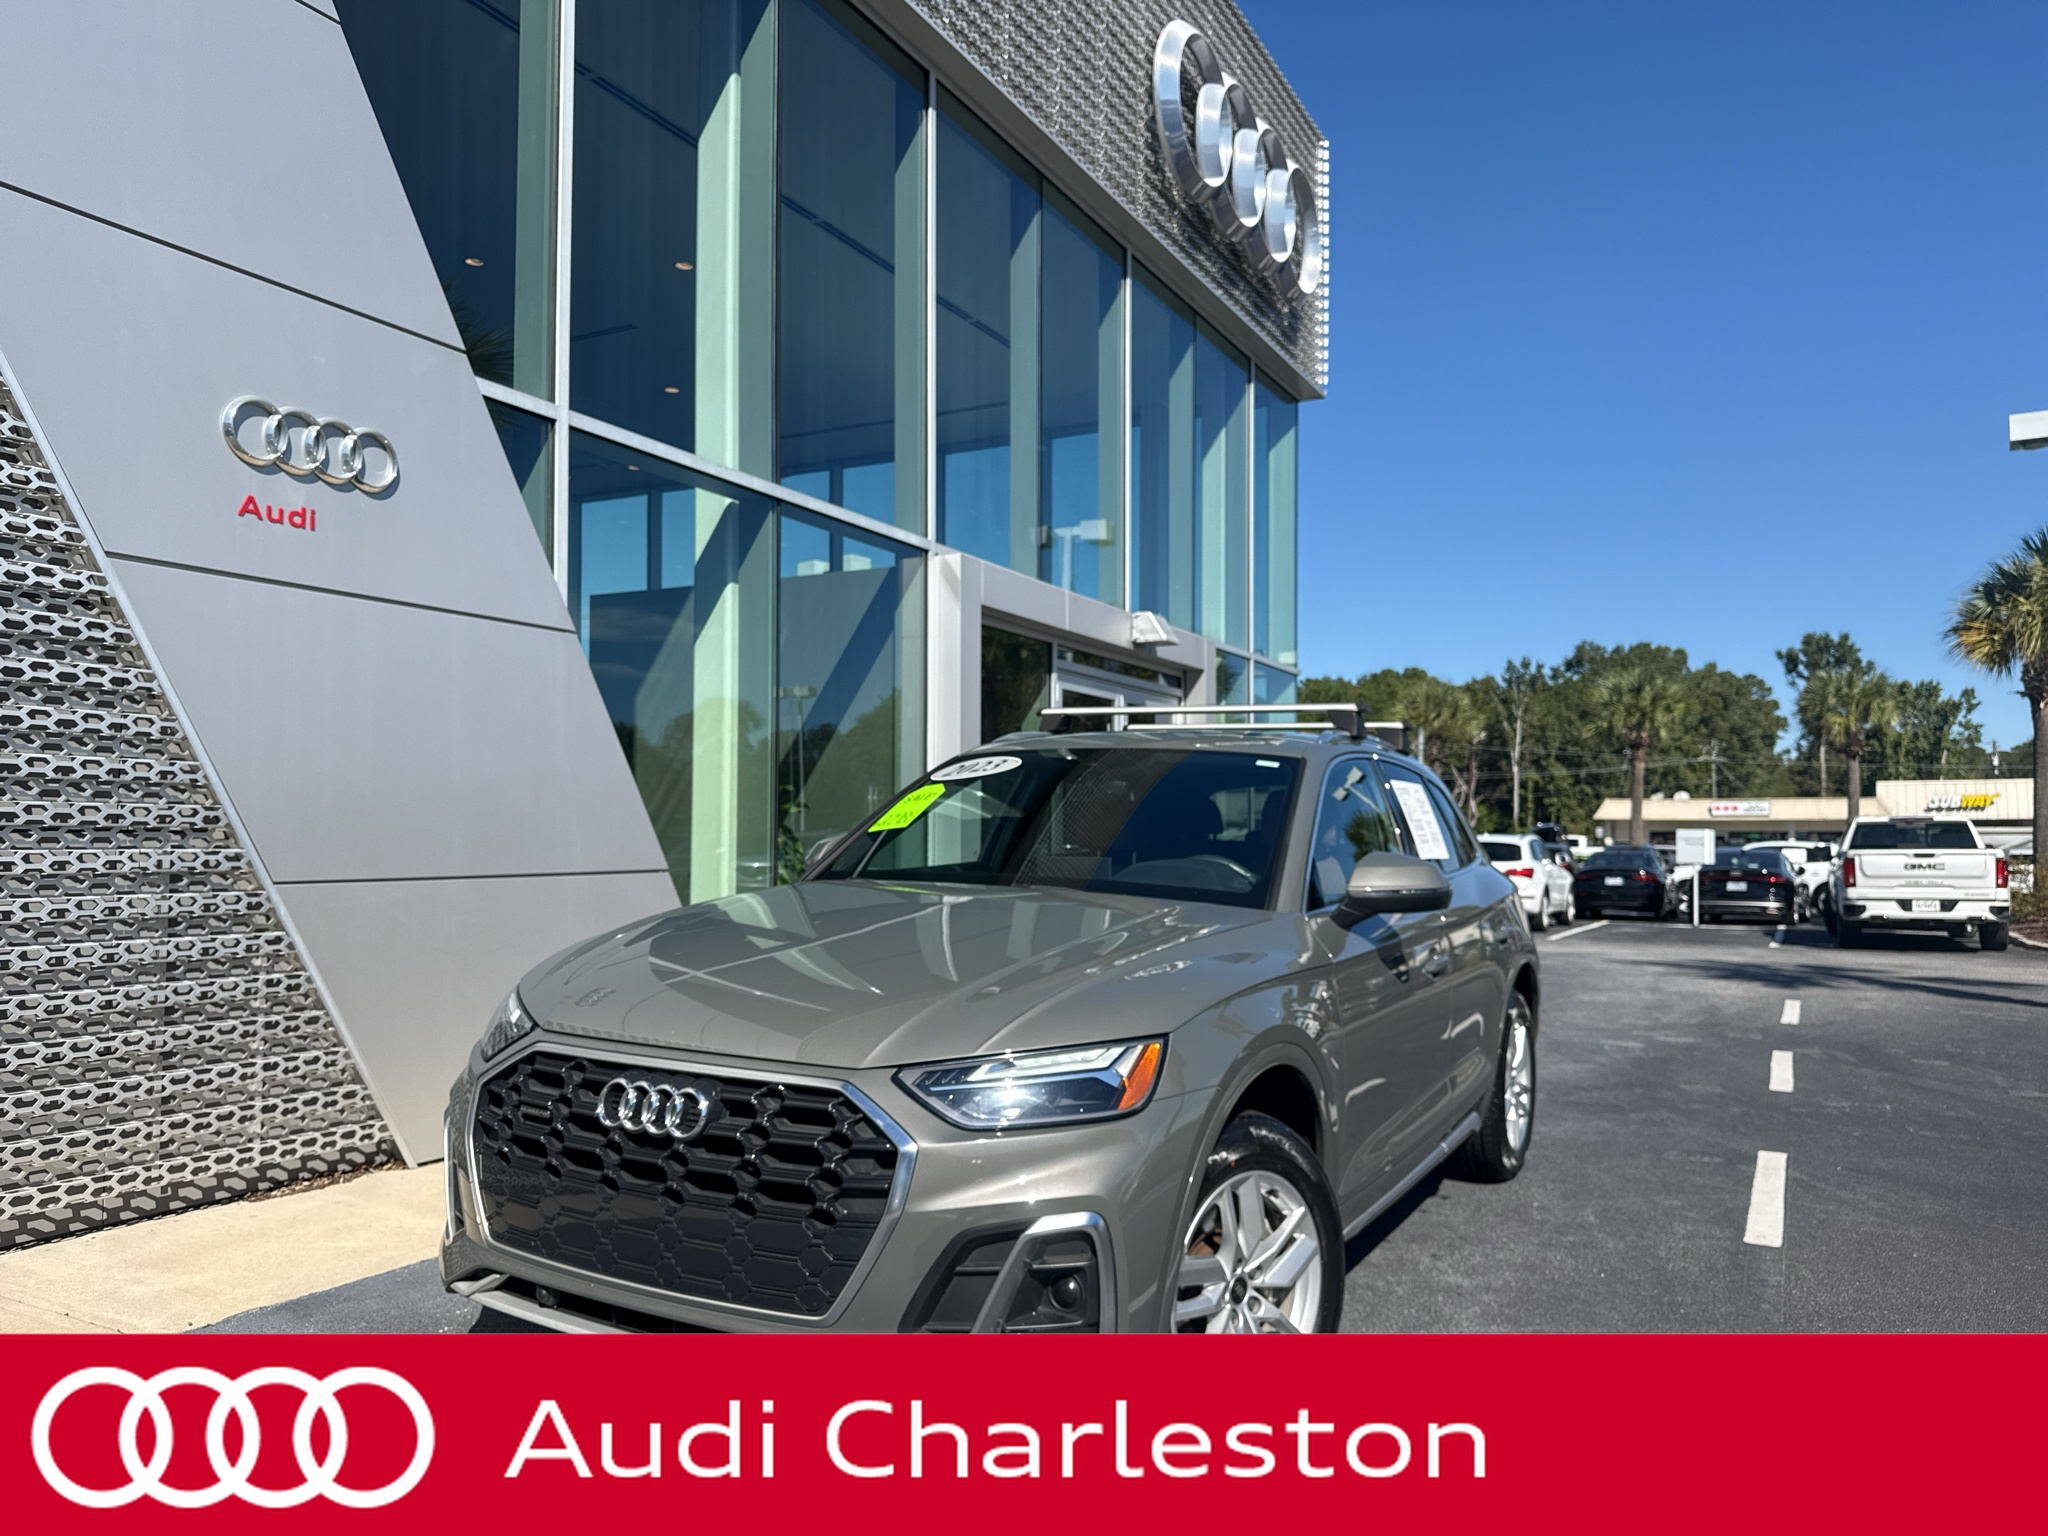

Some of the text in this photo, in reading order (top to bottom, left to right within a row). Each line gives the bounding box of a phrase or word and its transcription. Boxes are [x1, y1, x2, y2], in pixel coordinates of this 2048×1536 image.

[237, 494, 316, 531] Audi
[1926, 793, 2000, 810] SUBWAY
[1904, 863, 1946, 871] GMC
